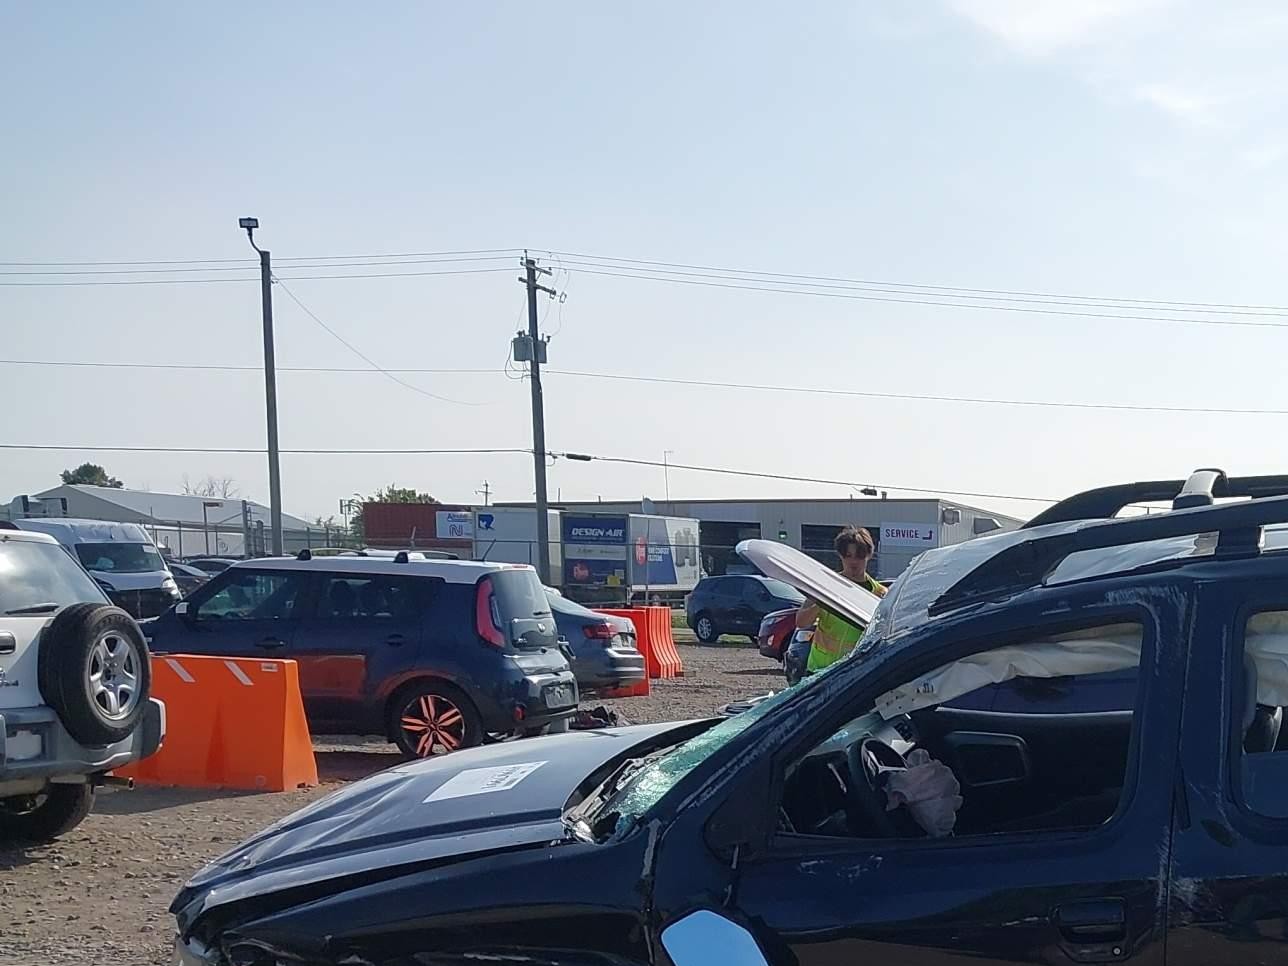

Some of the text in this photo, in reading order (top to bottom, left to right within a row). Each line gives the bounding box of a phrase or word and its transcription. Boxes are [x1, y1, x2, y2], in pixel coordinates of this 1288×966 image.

[571, 527, 623, 538] DESIGN AIR
[885, 529, 920, 539] SERVICE
